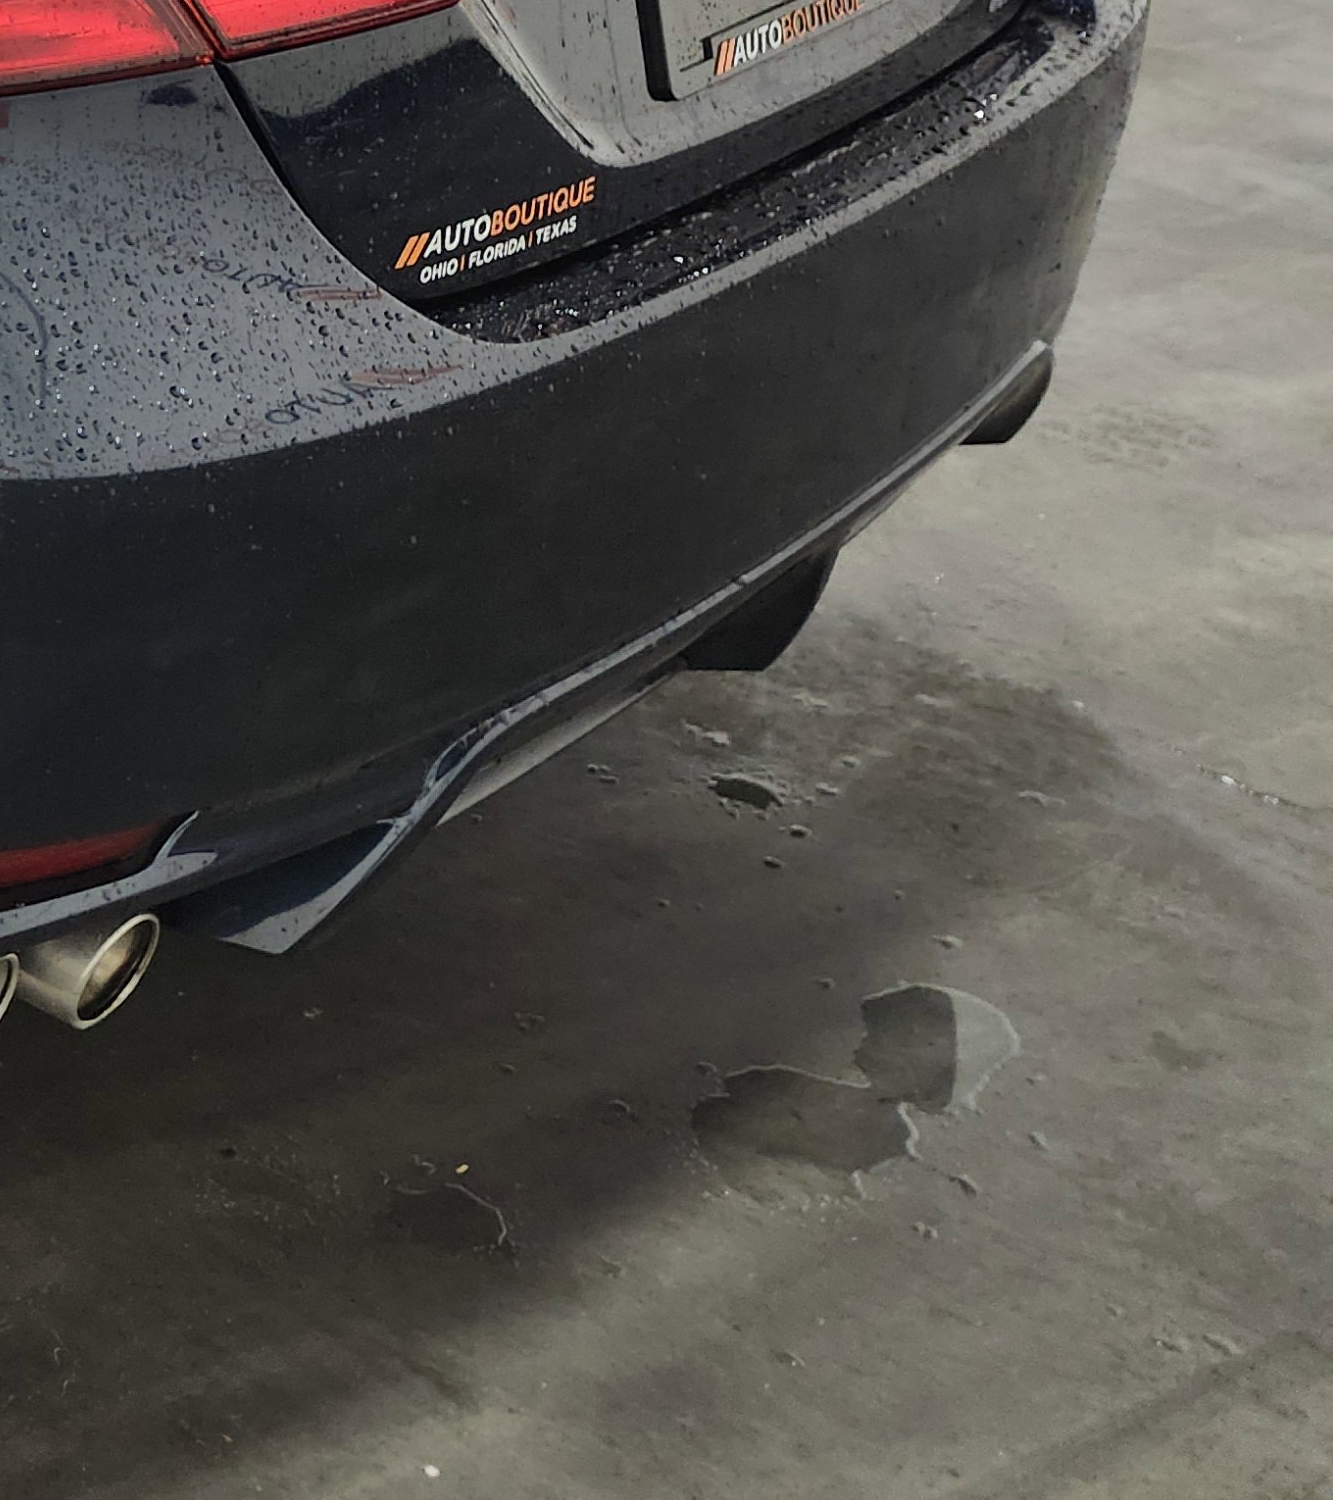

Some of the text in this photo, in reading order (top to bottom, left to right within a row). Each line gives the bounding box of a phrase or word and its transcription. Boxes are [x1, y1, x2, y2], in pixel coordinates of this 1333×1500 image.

[419, 215, 577, 284] OHIO FLORIDA TEXAS
[423, 176, 596, 259] AUTOBOUTIQUE
